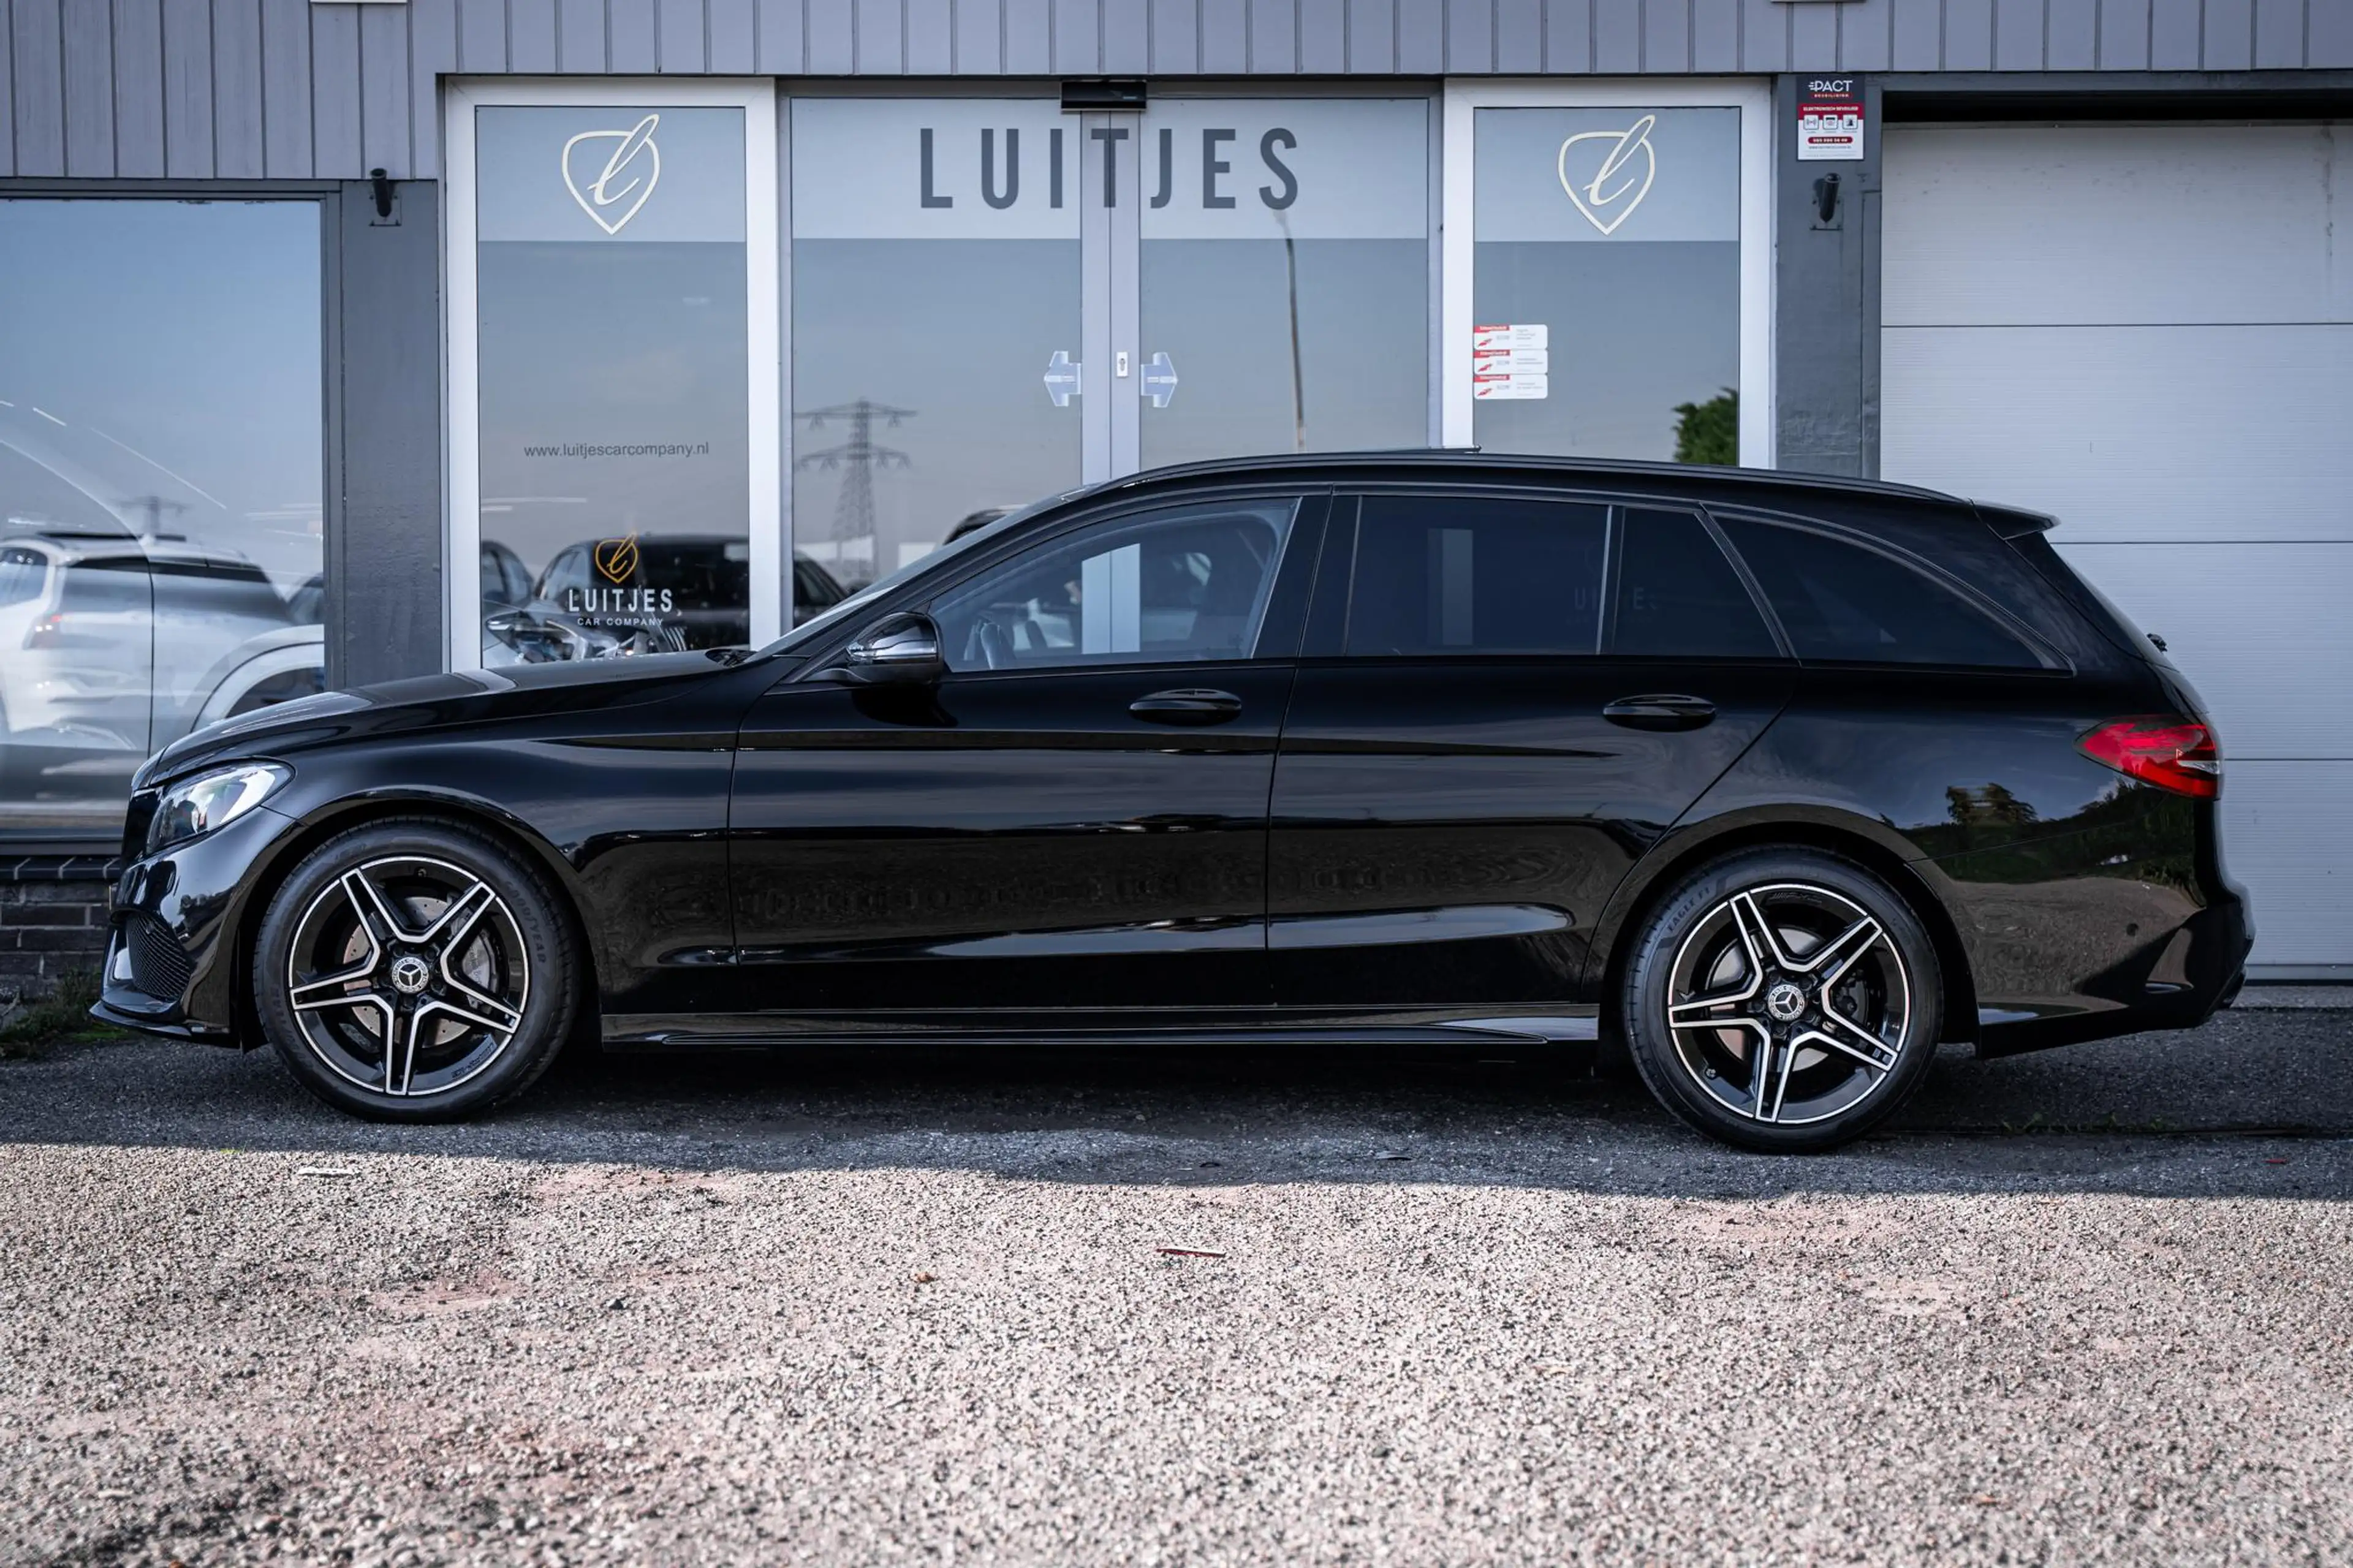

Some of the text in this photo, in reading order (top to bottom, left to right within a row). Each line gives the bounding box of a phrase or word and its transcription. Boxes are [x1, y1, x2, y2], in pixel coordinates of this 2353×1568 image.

[1812, 80, 1852, 91] PACT
[920, 127, 1298, 210] LUITJES
[524, 442, 709, 458] www.luitjescarcompany.nl
[569, 589, 673, 612] LUITJES
[577, 617, 664, 626] CAR COMPANY
